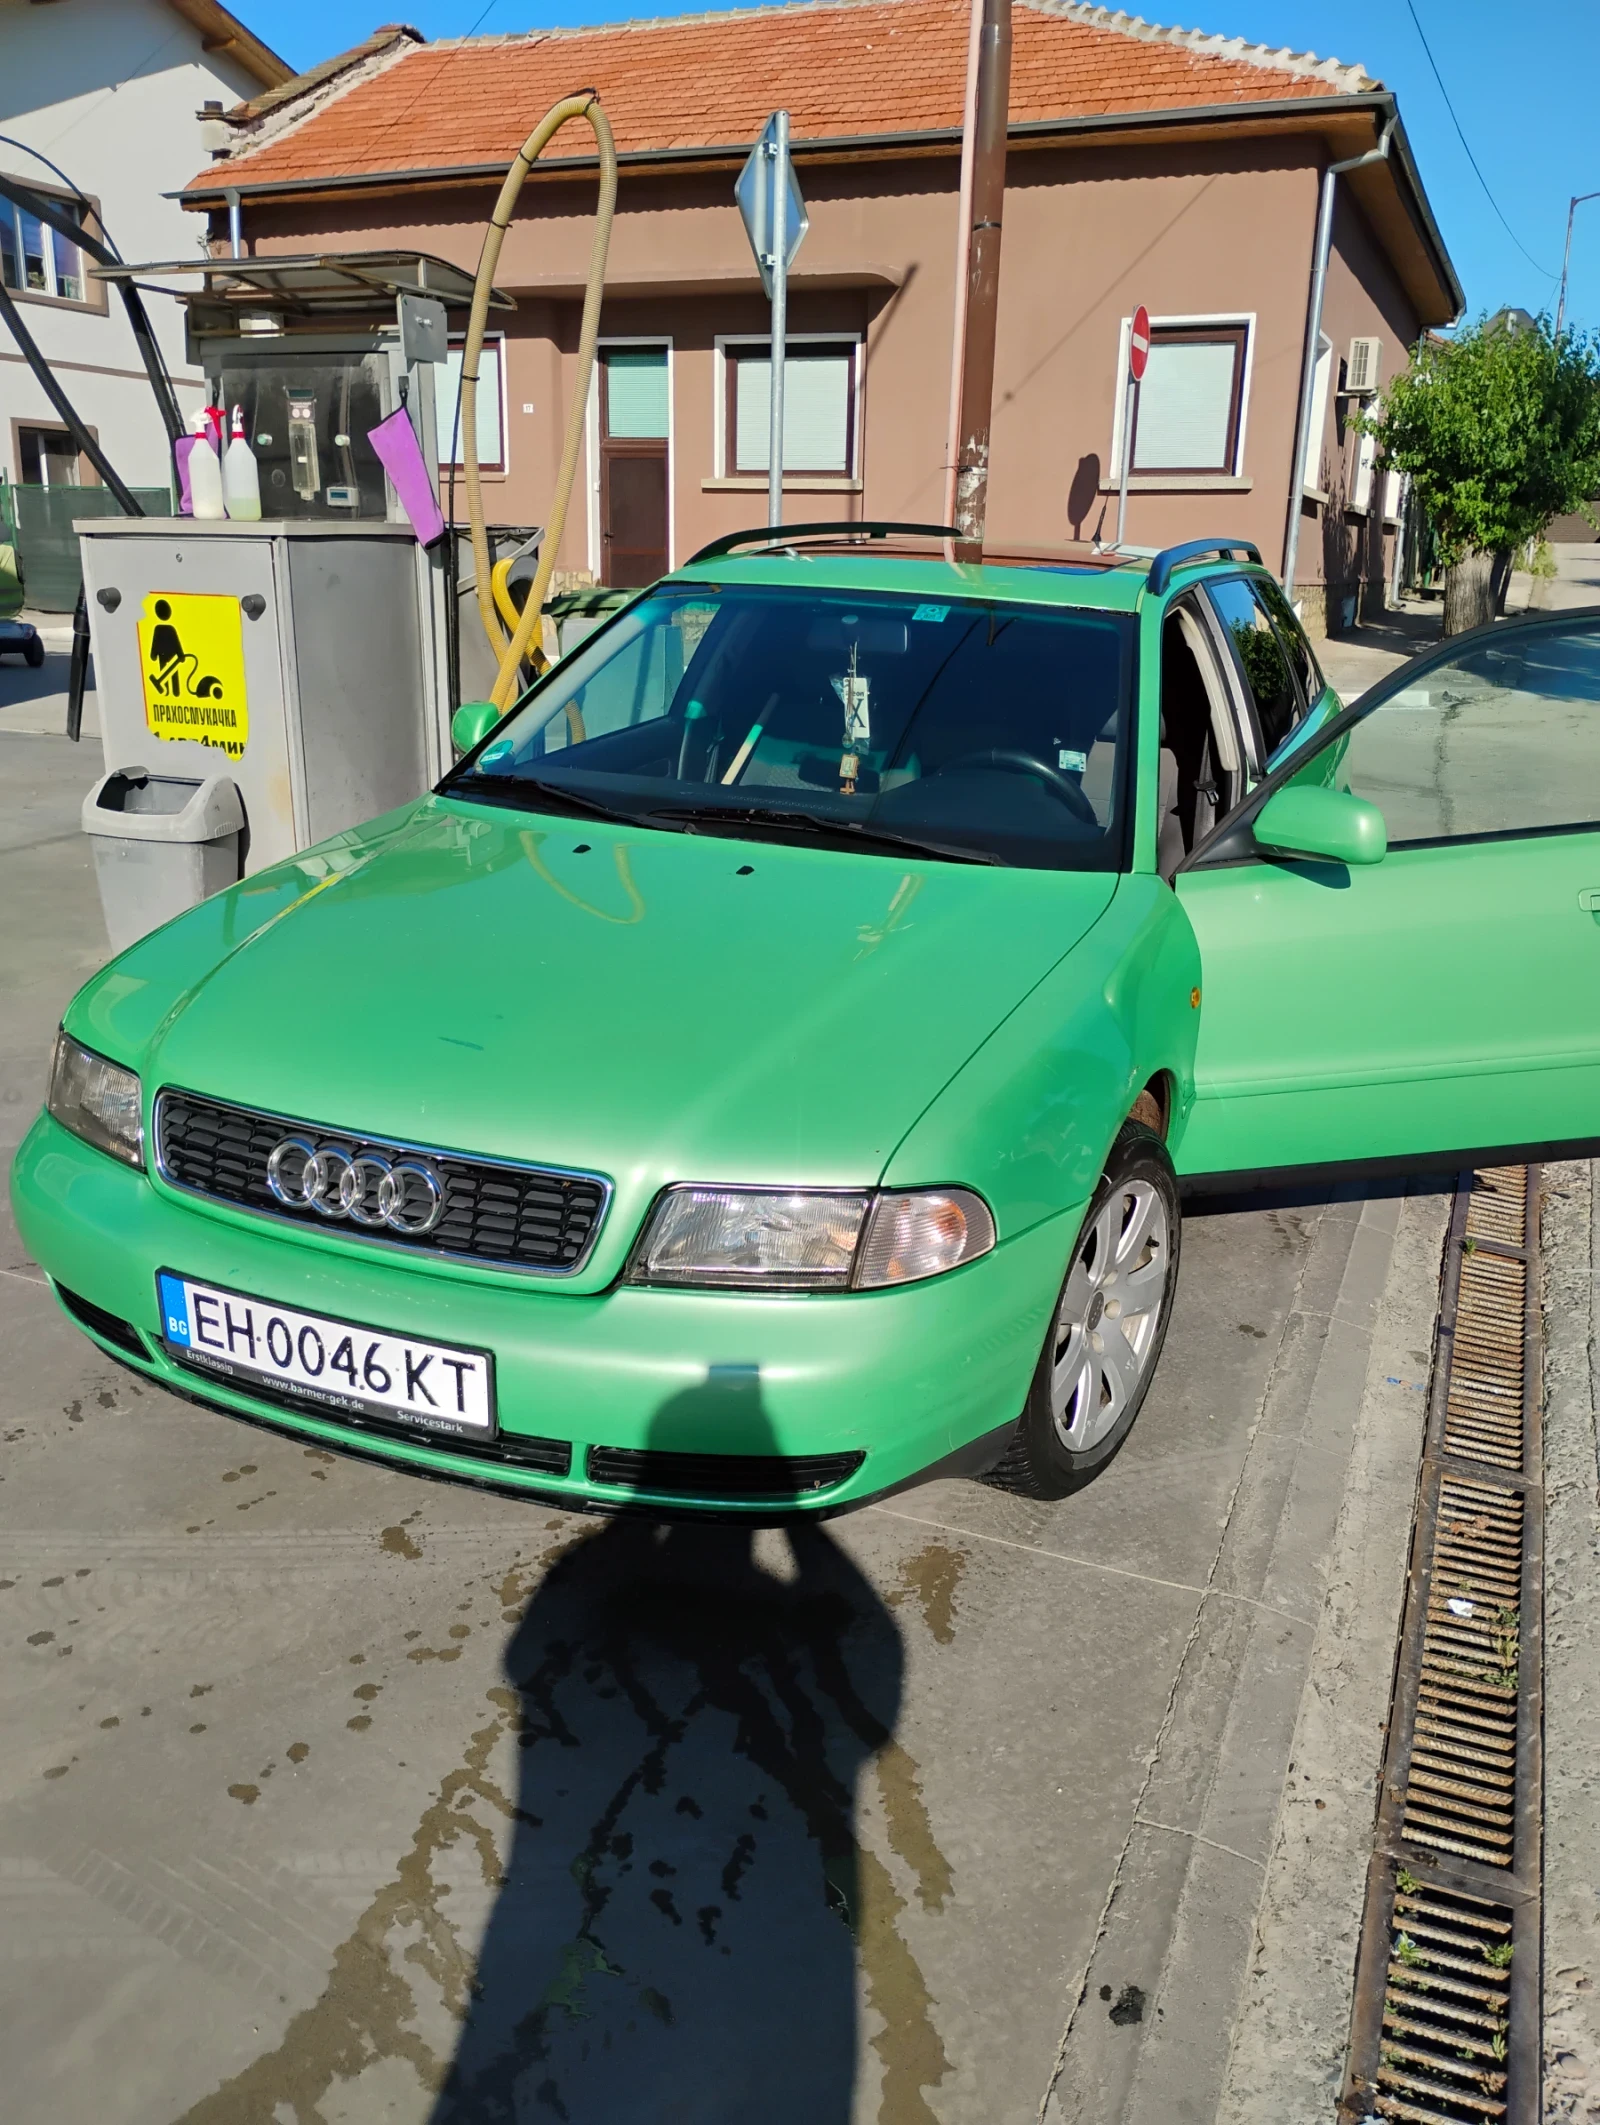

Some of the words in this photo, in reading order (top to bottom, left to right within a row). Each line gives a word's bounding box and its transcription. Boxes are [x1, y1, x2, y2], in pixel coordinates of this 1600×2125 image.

[153, 704, 237, 728] ПРАХОСМУКАЧКА
[168, 1316, 189, 1336] BG
[193, 1292, 257, 1360] EH
[267, 1317, 393, 1393] 0046
[404, 1349, 477, 1413] KT
[186, 1349, 234, 1375] Erstklassig
[262, 1375, 365, 1410] www.barmer-gek.de
[397, 1410, 464, 1433] Servicestark
